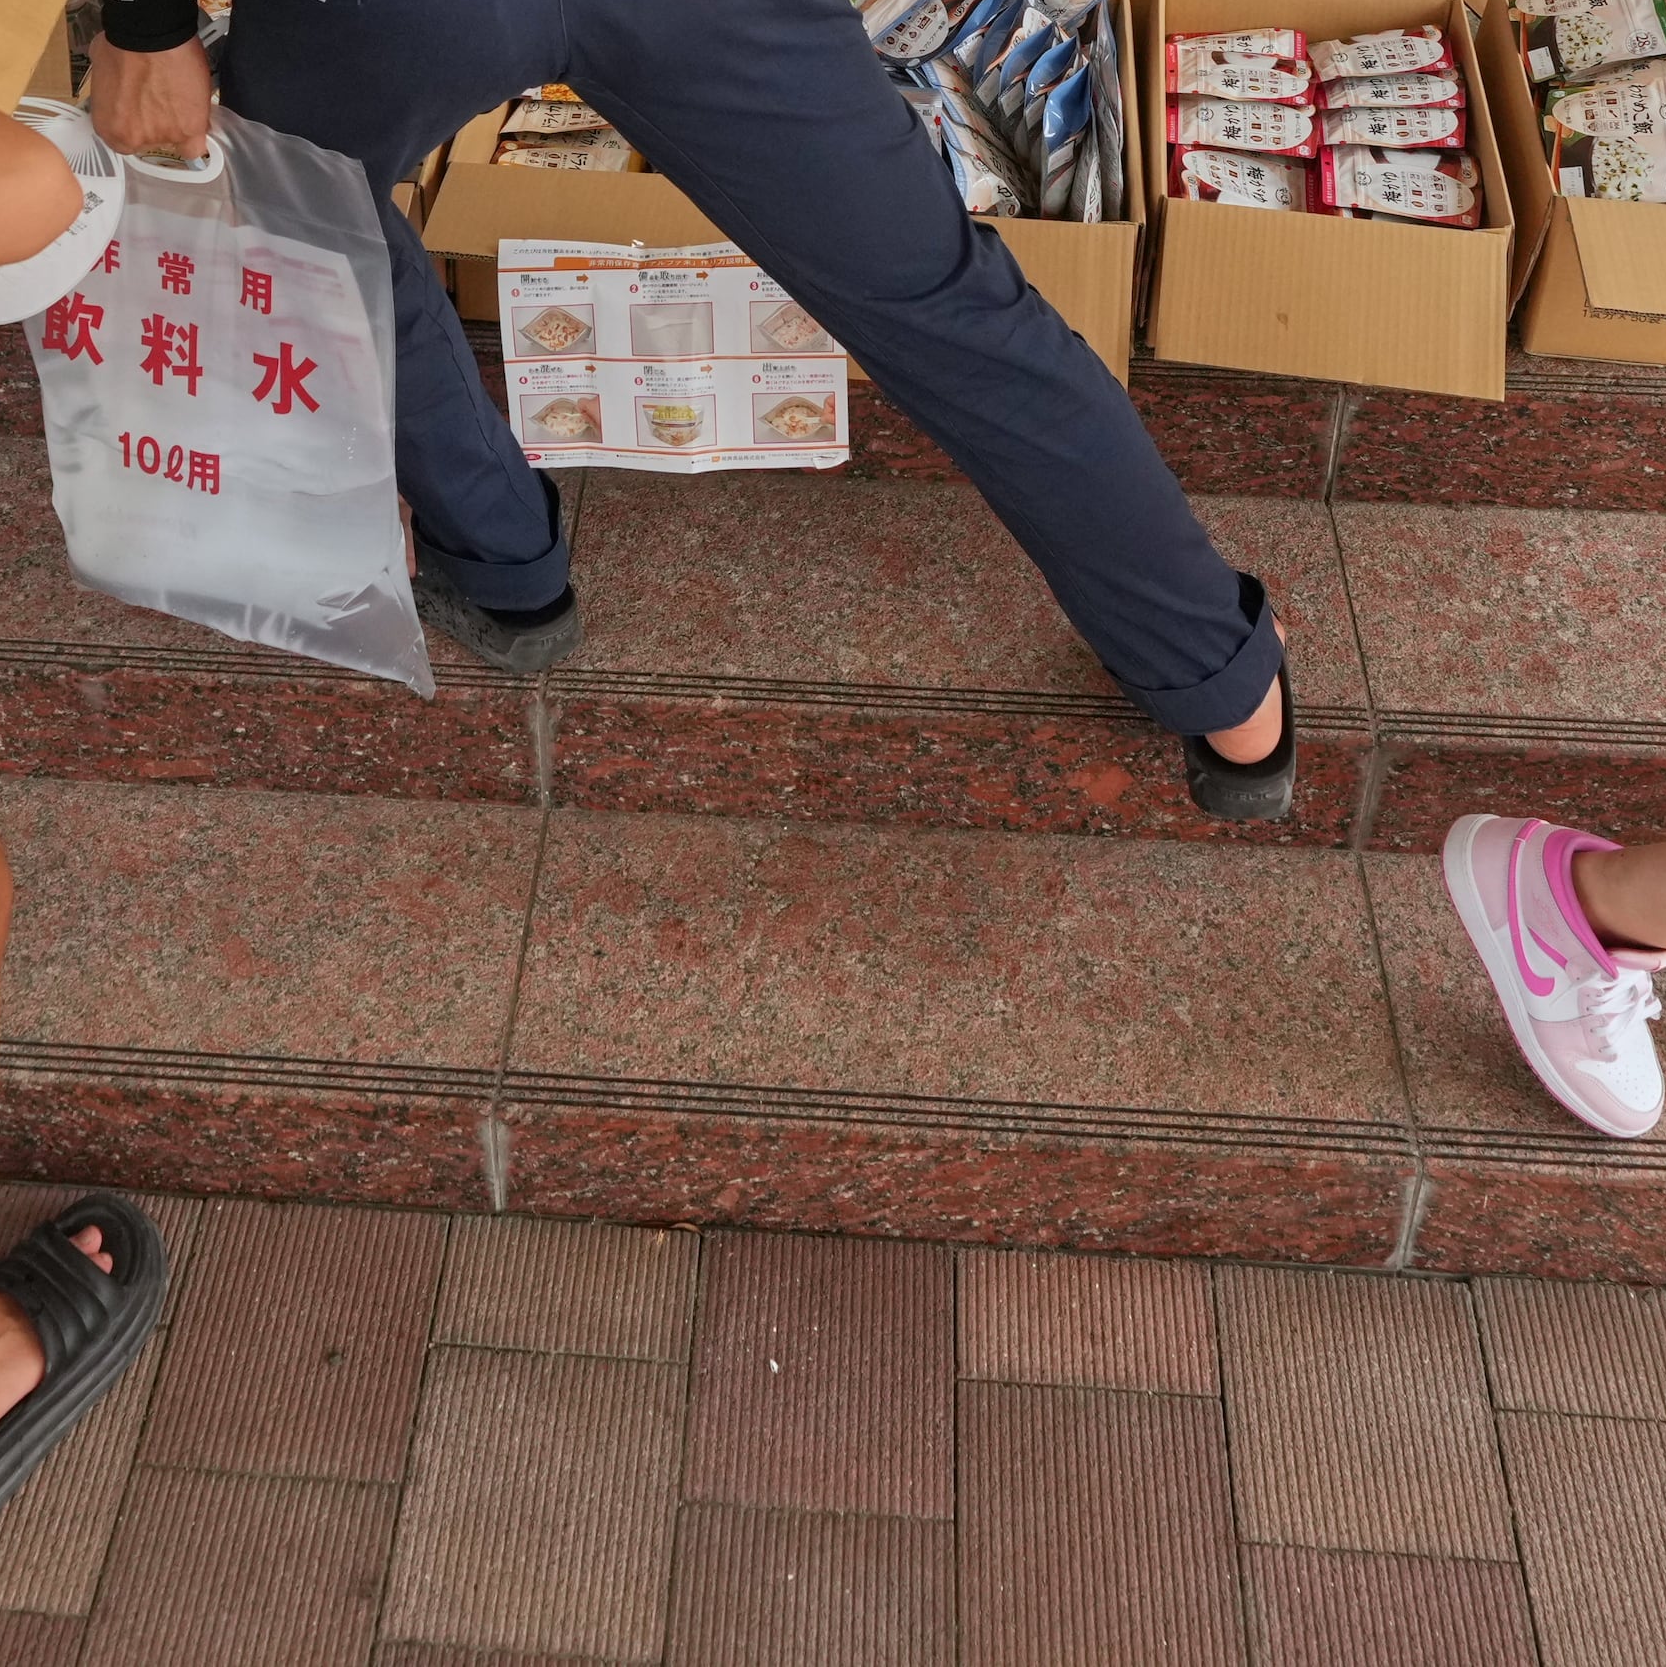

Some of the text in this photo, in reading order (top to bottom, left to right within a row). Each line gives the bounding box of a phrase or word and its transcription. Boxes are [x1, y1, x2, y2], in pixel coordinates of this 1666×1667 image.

[1223, 104, 1241, 141] 梅がゆ
[1628, 84, 1654, 136] わかめご飯
[1245, 165, 1270, 204] 梅がゆ
[1381, 171, 1403, 205] 梅がゆ
[41, 291, 321, 415] 飲料水
